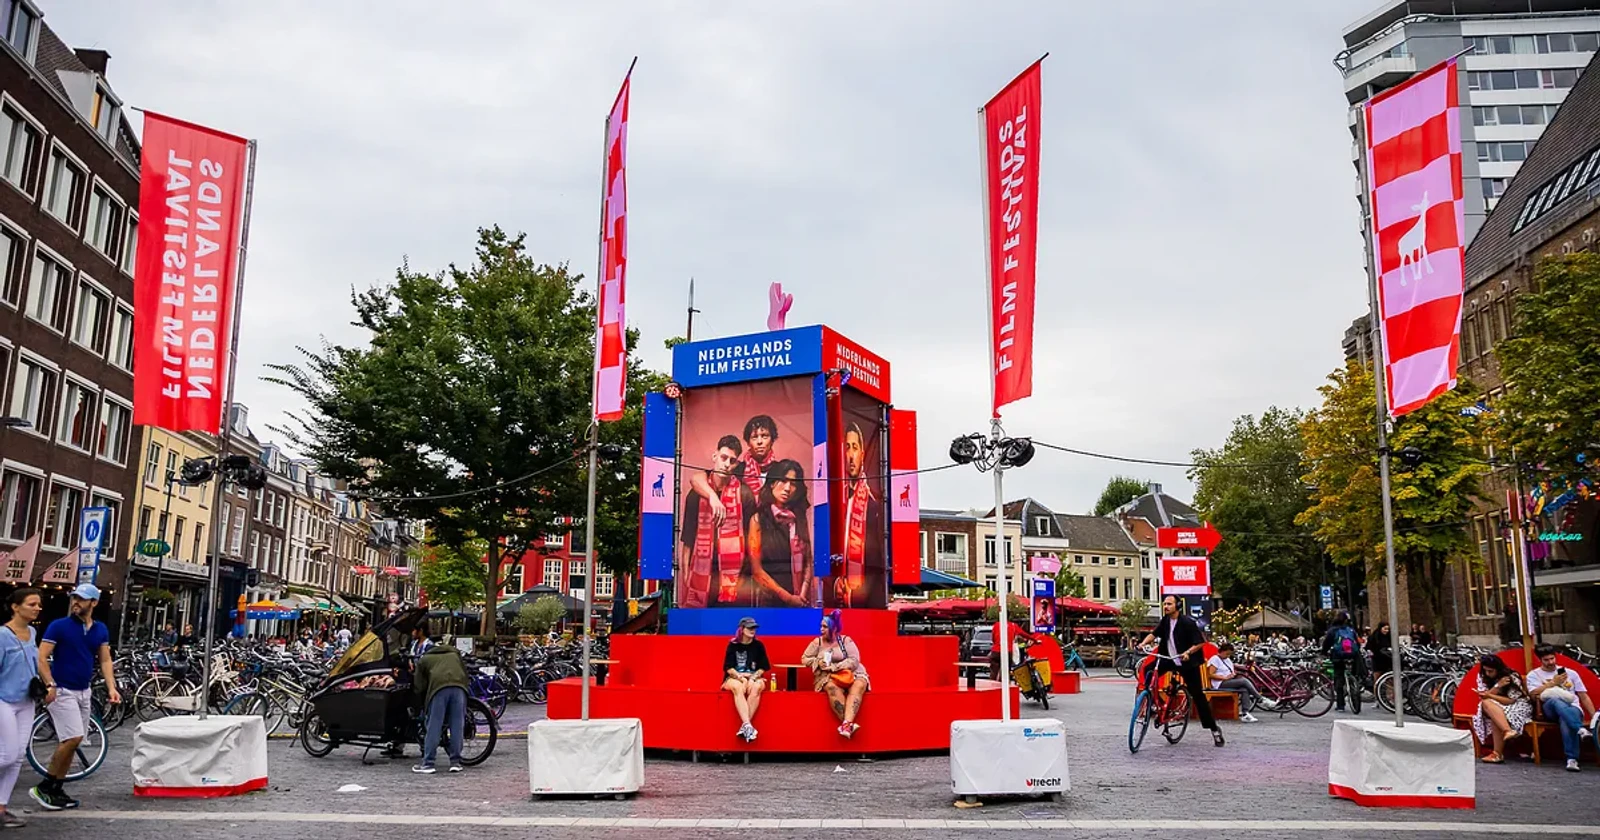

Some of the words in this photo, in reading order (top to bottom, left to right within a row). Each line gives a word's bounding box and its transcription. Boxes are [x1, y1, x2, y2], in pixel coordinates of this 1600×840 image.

[1003, 105, 1027, 273] FESTIVAL
[999, 281, 1017, 373] FILM
[698, 338, 792, 362] NEDERLANDS
[836, 343, 880, 376] NEDERLANDS
[698, 363, 728, 376] FILM
[731, 353, 792, 372] FESTIVAL
[836, 357, 852, 372] FILM
[853, 366, 880, 390] FESTIVAL
[8, 560, 27, 568] THE
[55, 562, 72, 570] THE
